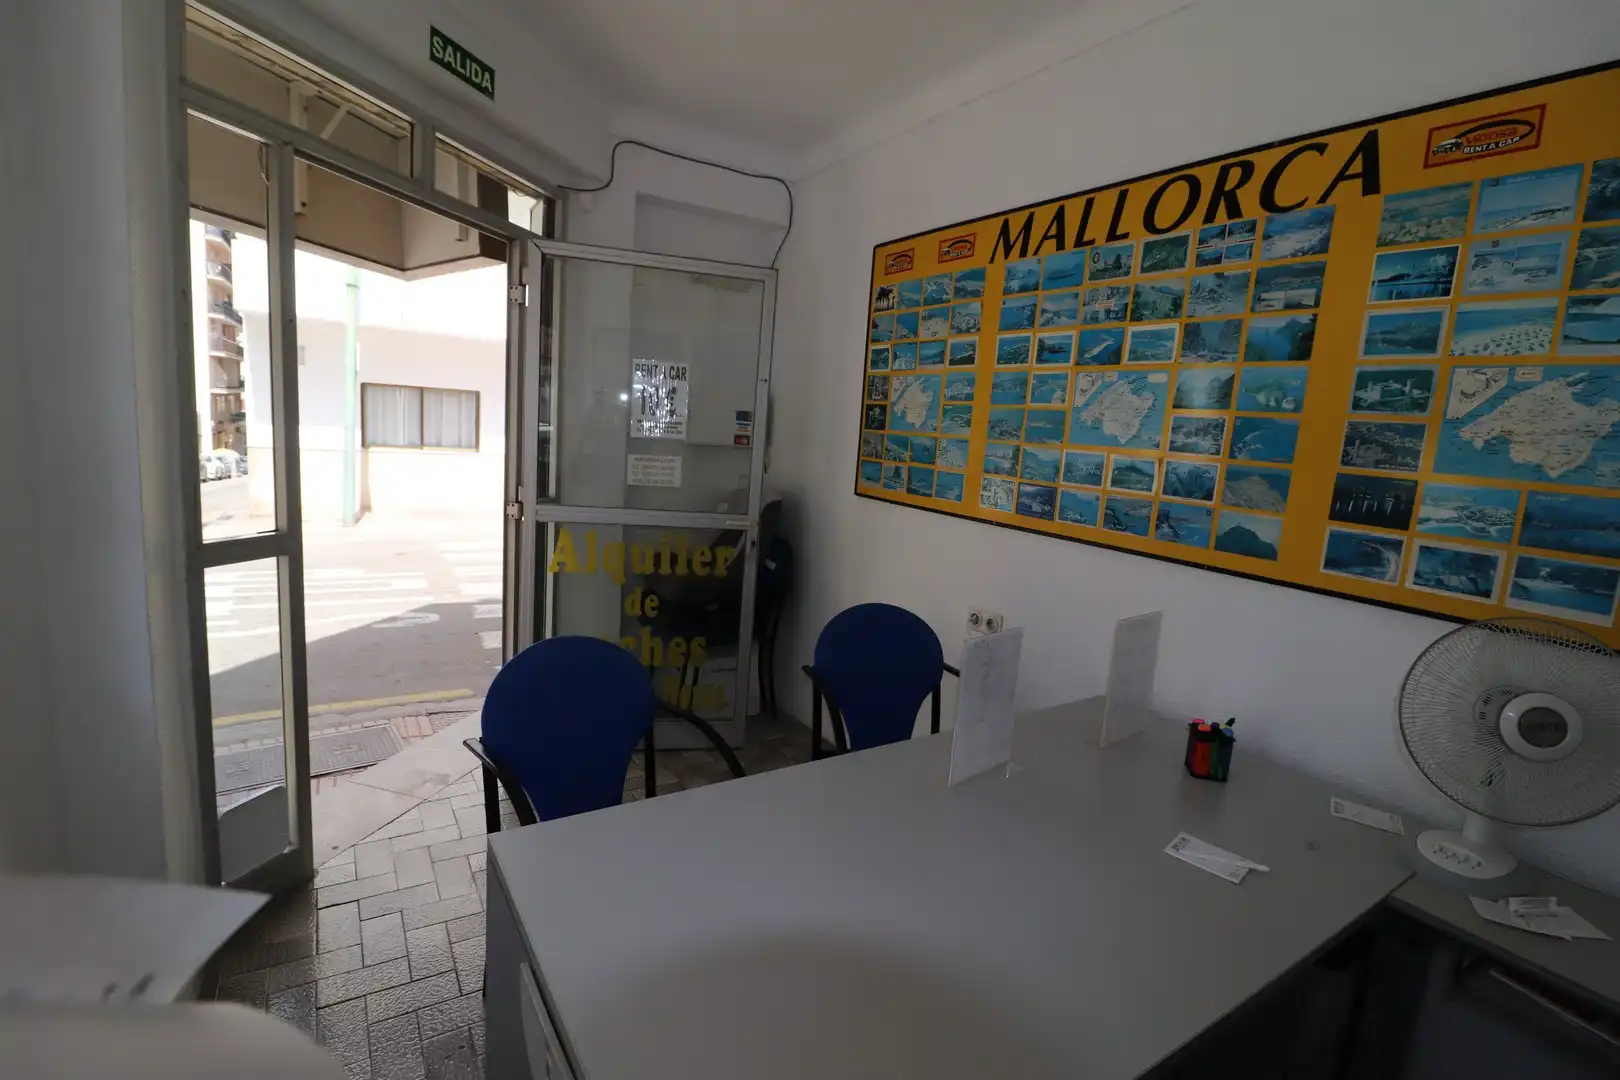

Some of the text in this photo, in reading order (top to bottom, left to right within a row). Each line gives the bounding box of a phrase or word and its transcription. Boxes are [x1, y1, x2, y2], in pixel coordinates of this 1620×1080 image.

[433, 36, 492, 92] SALIDA
[1464, 136, 1520, 154] RENT A CAR
[989, 129, 1381, 264] MALLORCA
[669, 366, 687, 381] CAR
[549, 528, 735, 586] Alquiler
[625, 587, 660, 619] de
